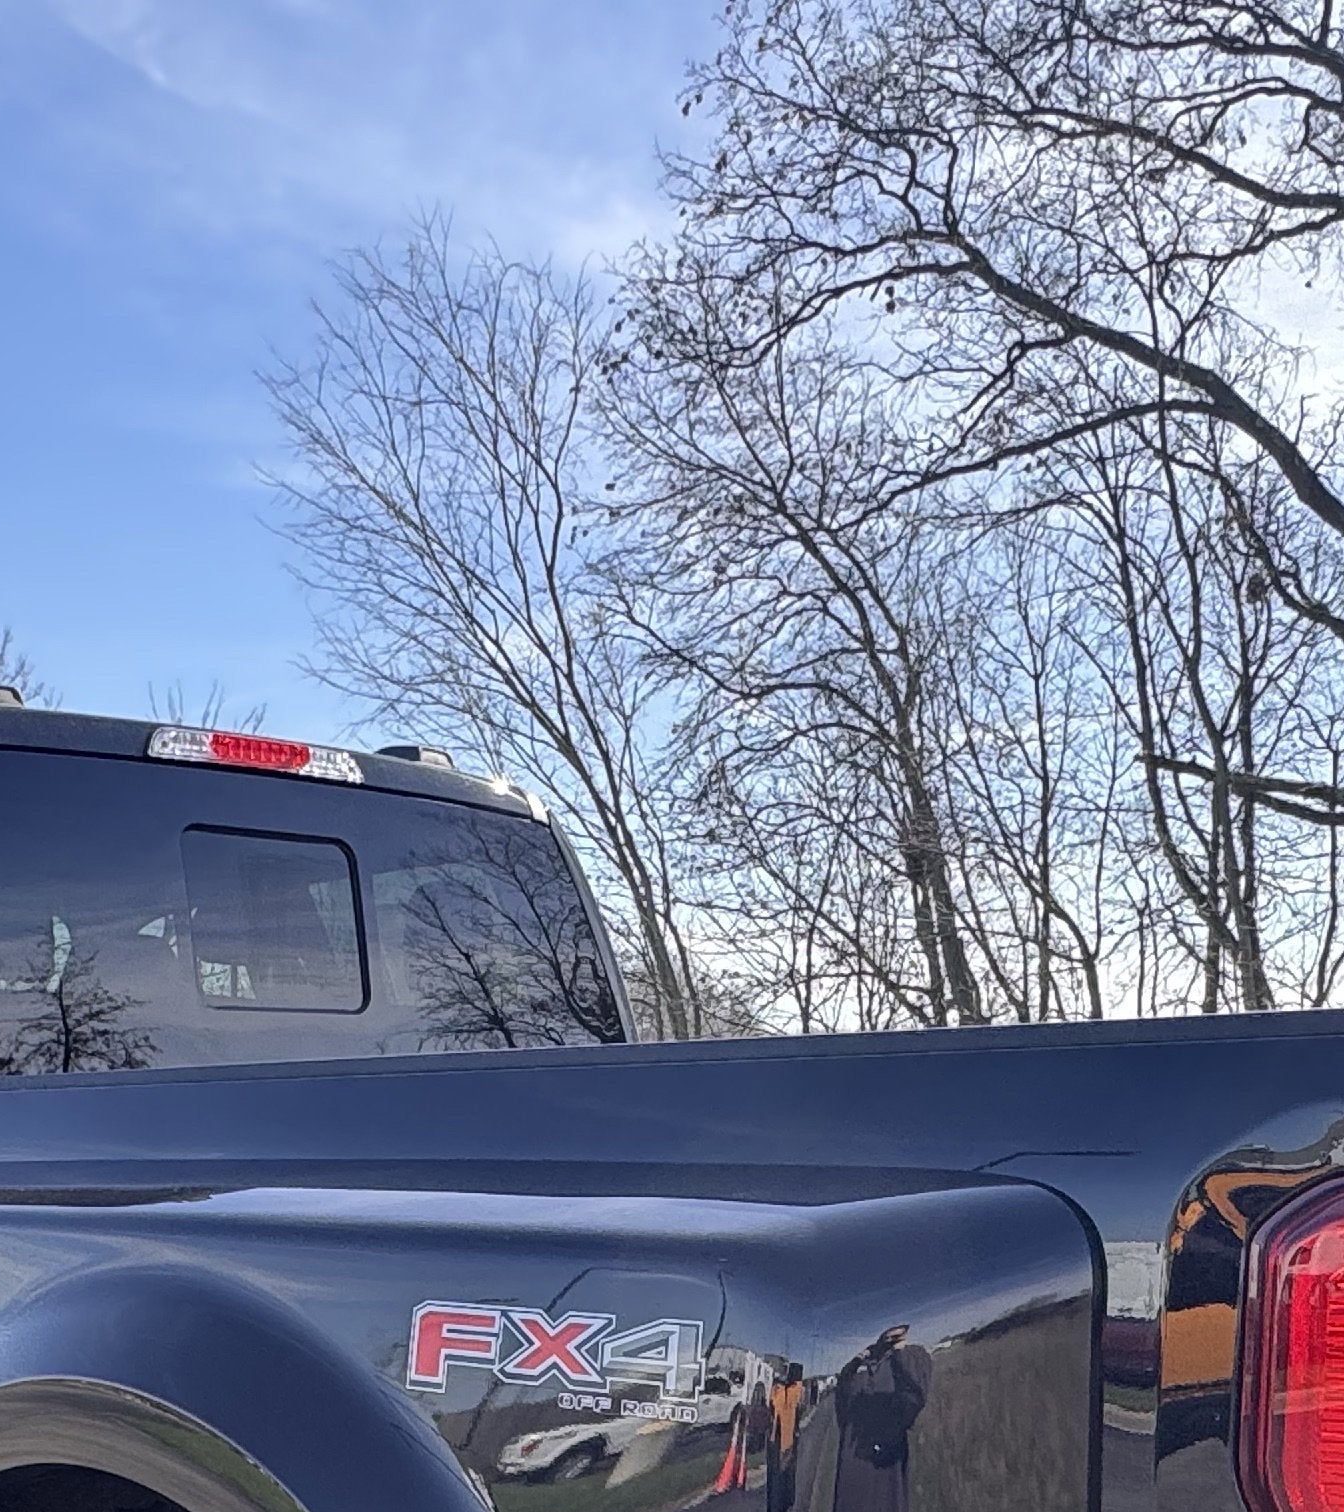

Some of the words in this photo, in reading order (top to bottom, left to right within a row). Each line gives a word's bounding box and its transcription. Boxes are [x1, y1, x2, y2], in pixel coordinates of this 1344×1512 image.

[406, 1300, 705, 1403] FX4
[558, 1392, 612, 1413] OFF
[620, 1399, 698, 1424] ROAD
